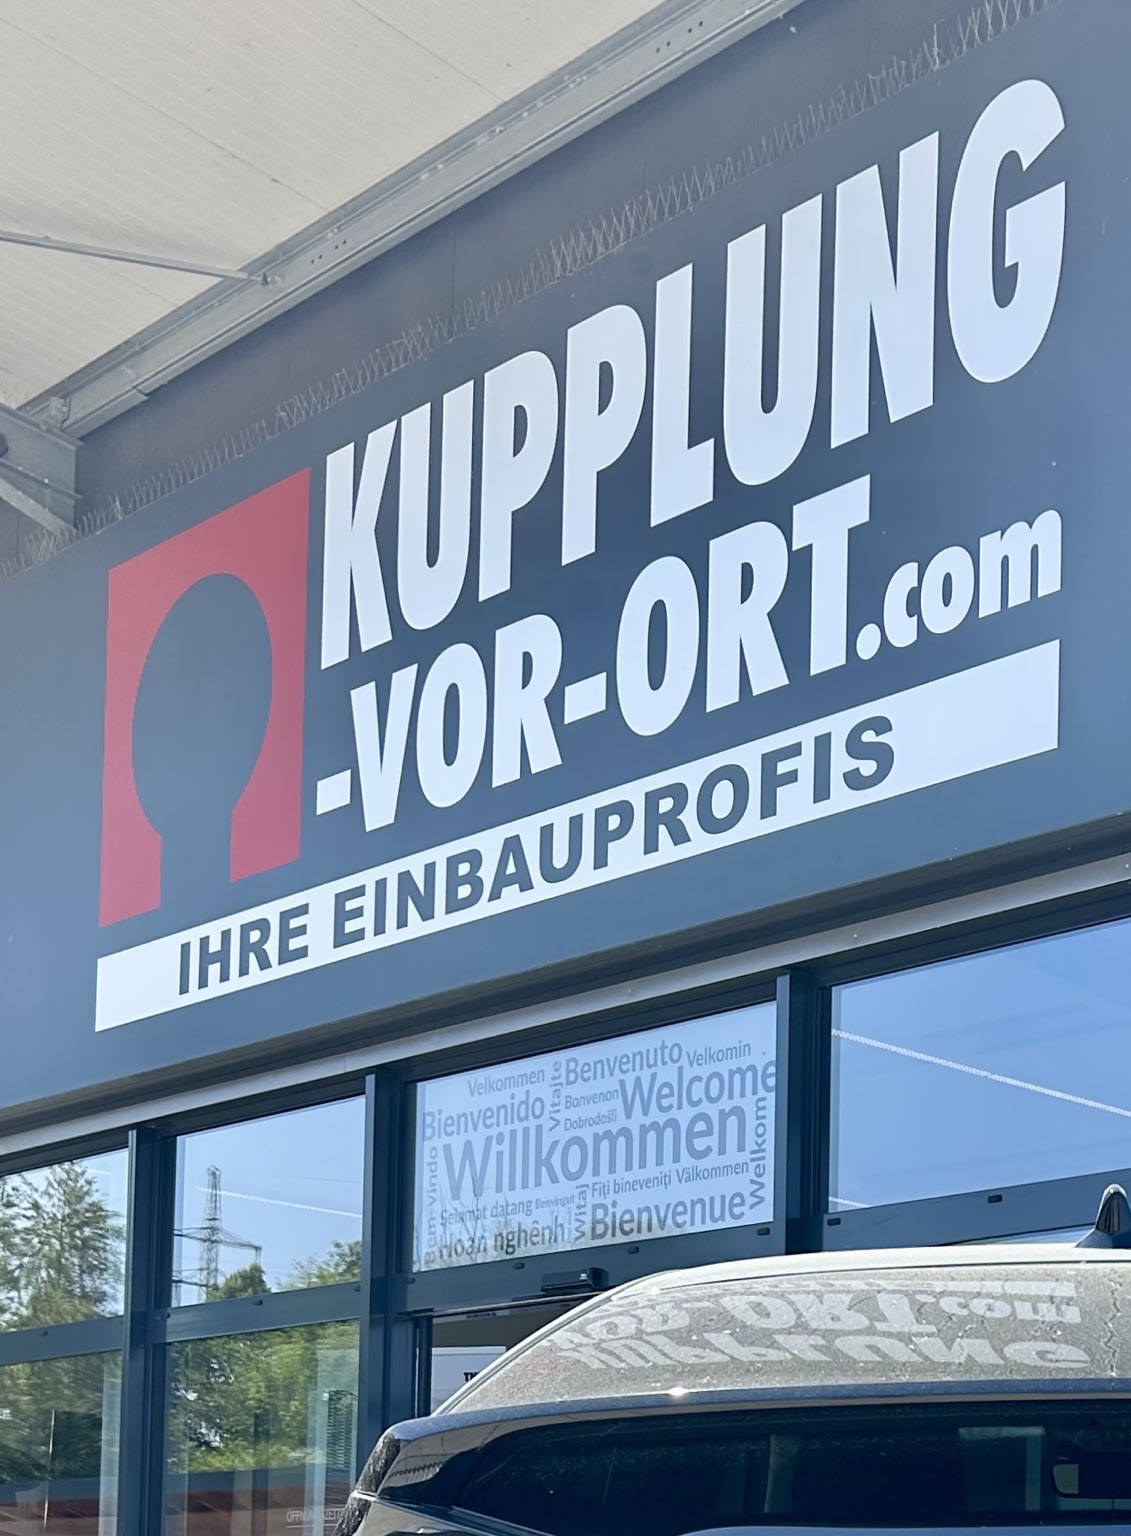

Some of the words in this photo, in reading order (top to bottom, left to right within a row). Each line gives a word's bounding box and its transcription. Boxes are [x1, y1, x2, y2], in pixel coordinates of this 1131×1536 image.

[320, 78, 1067, 670] KUPPLUNG
[178, 902, 310, 996] IHRE
[332, 715, 896, 949] EINBAUPROFIS
[565, 1040, 683, 1086] Benvenuto
[686, 1040, 752, 1068] Velkomin
[467, 1068, 546, 1098] Velkommen
[548, 1059, 564, 1132] Vitajte
[565, 1088, 619, 1110] Bonvenon
[618, 1059, 776, 1120] Welcome
[423, 1090, 546, 1142] Bienvenido
[442, 1105, 747, 1201] Willkommen
[676, 1161, 749, 1185] Välkommen
[749, 1096, 767, 1210] Welkom
[491, 1198, 534, 1217] datang
[573, 1183, 590, 1244] Witaj
[590, 1191, 747, 1242] Bienvenue
